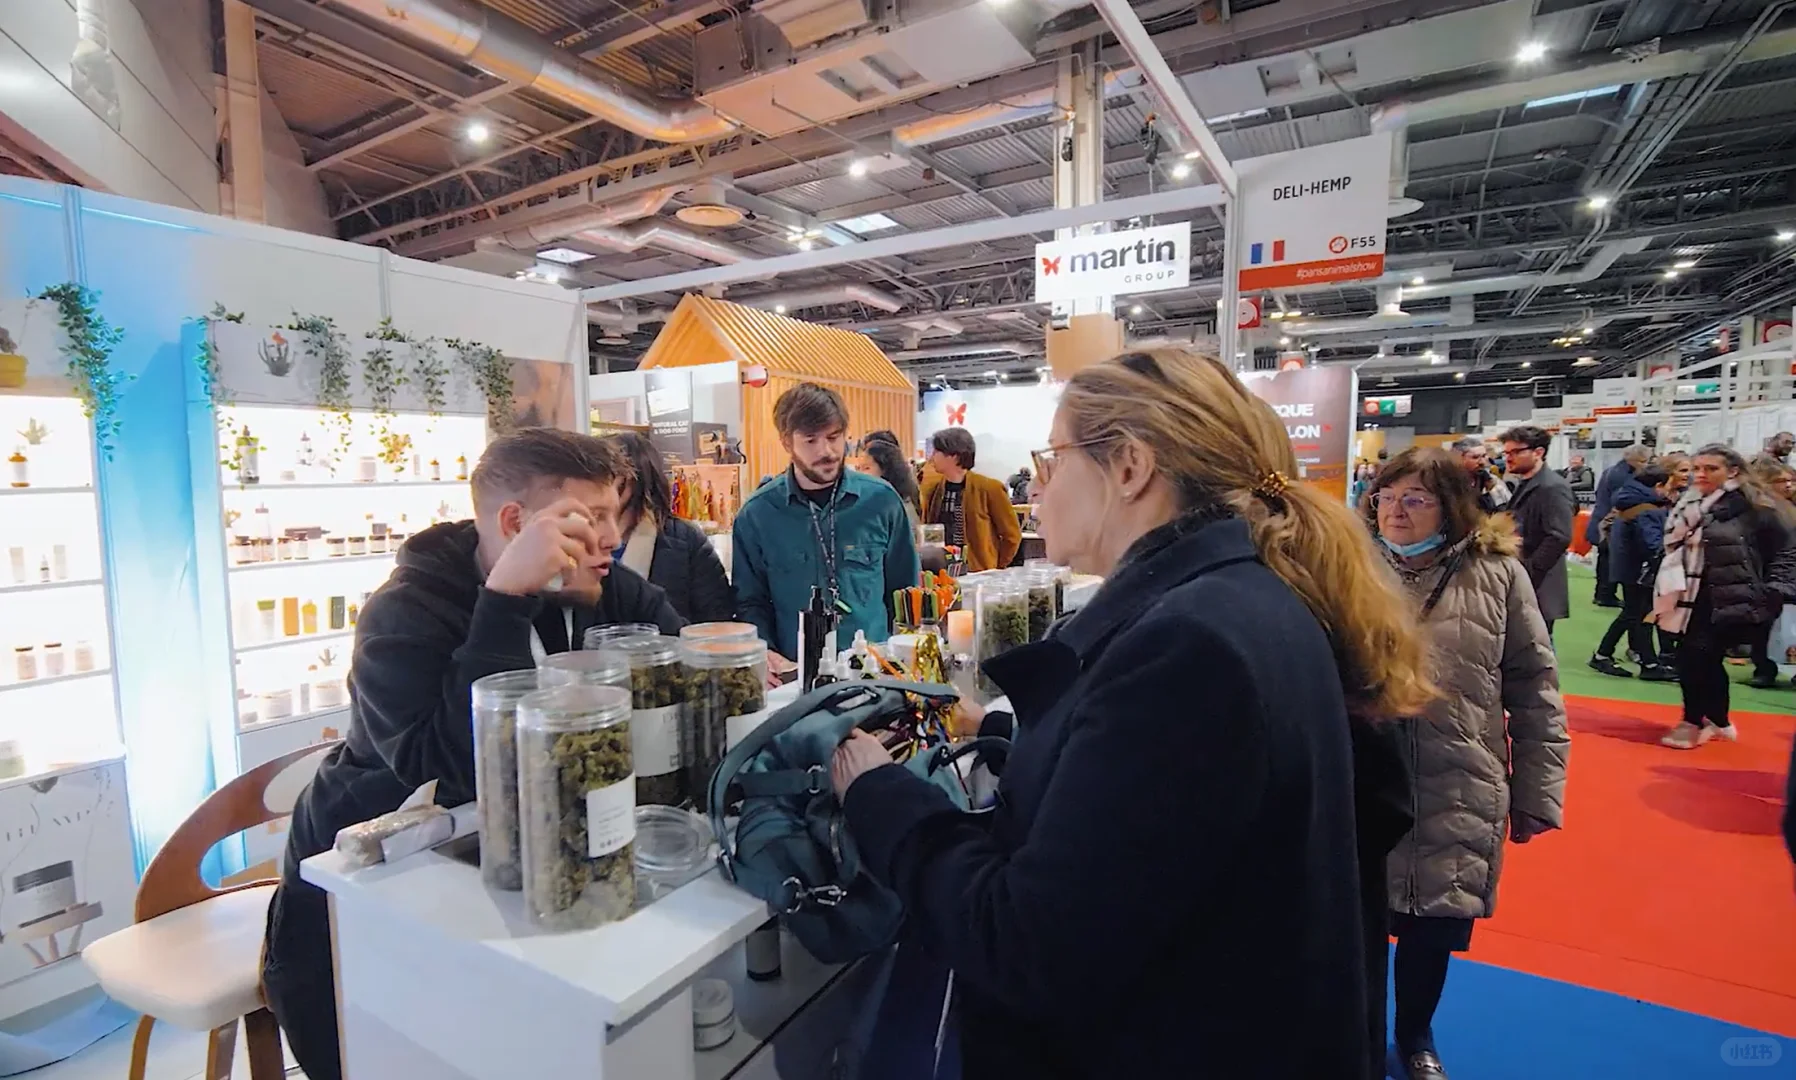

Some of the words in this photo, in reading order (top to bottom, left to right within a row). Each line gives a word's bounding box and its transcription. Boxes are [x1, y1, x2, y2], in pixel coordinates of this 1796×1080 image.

[1273, 176, 1352, 200] DELI-HEMP
[1350, 235, 1377, 249] F55
[1070, 237, 1176, 273] martin
[1124, 270, 1176, 283] GROUP
[1286, 424, 1321, 439] LON
